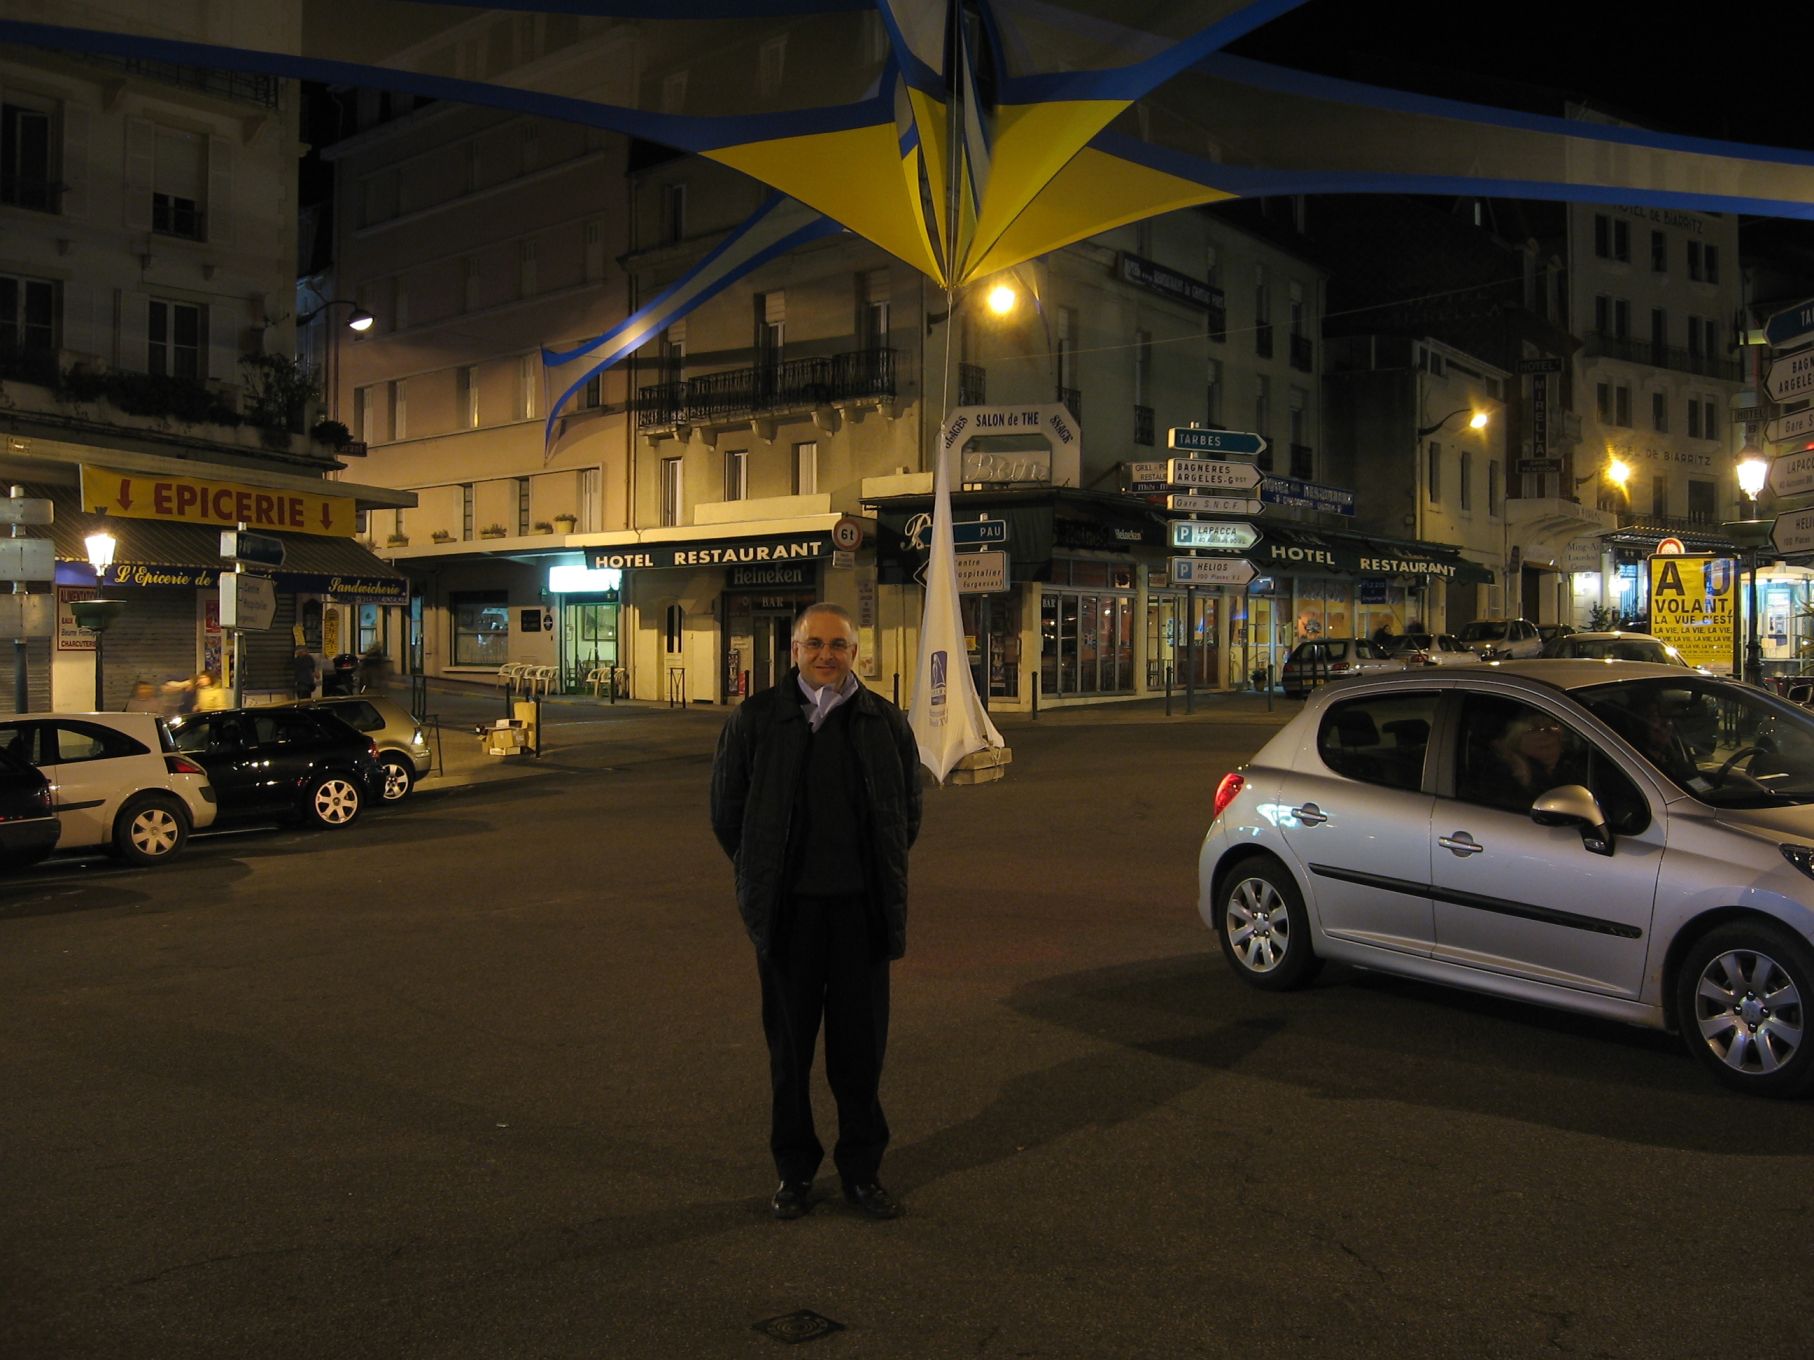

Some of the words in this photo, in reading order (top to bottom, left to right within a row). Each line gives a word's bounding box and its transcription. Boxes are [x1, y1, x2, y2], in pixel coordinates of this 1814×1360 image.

[1801, 308, 1814, 327] TA
[1779, 372, 1814, 394] ARGELE
[976, 413, 1004, 427] SALON
[1008, 413, 1018, 426] de
[1022, 412, 1039, 425] THE
[1535, 379, 1544, 453] MIRELLA
[1178, 433, 1221, 446] TARBES
[1664, 451, 1711, 466] BIARRITZ
[154, 483, 305, 527] EPICERIE
[1176, 499, 1197, 508] Gare
[1796, 516, 1814, 530] HELI
[980, 526, 1001, 537] PAU
[1180, 526, 1189, 540] P
[1197, 526, 1237, 536] LAPACCA
[594, 554, 653, 568] HOTEL
[674, 541, 822, 566] RESTAURANT
[1271, 545, 1335, 565] HOTEL
[1360, 557, 1456, 577] RESTAURANT
[114, 564, 192, 586] L'Epicerie
[194, 570, 214, 587] de
[734, 567, 803, 585] Heineken
[958, 569, 1001, 579] ospitalier
[1180, 562, 1189, 576] P
[1197, 563, 1228, 571] HELIOS
[328, 577, 401, 595] Sandwicherie
[762, 596, 784, 608] BAR
[1655, 598, 1733, 616] VOLANT,
[1655, 615, 1668, 625] LA
[1675, 615, 1696, 625] VUE
[1703, 615, 1733, 625] C'EST
[1654, 626, 1664, 634] LA
[1681, 626, 1691, 634] LA
[1708, 626, 1718, 634] LA
